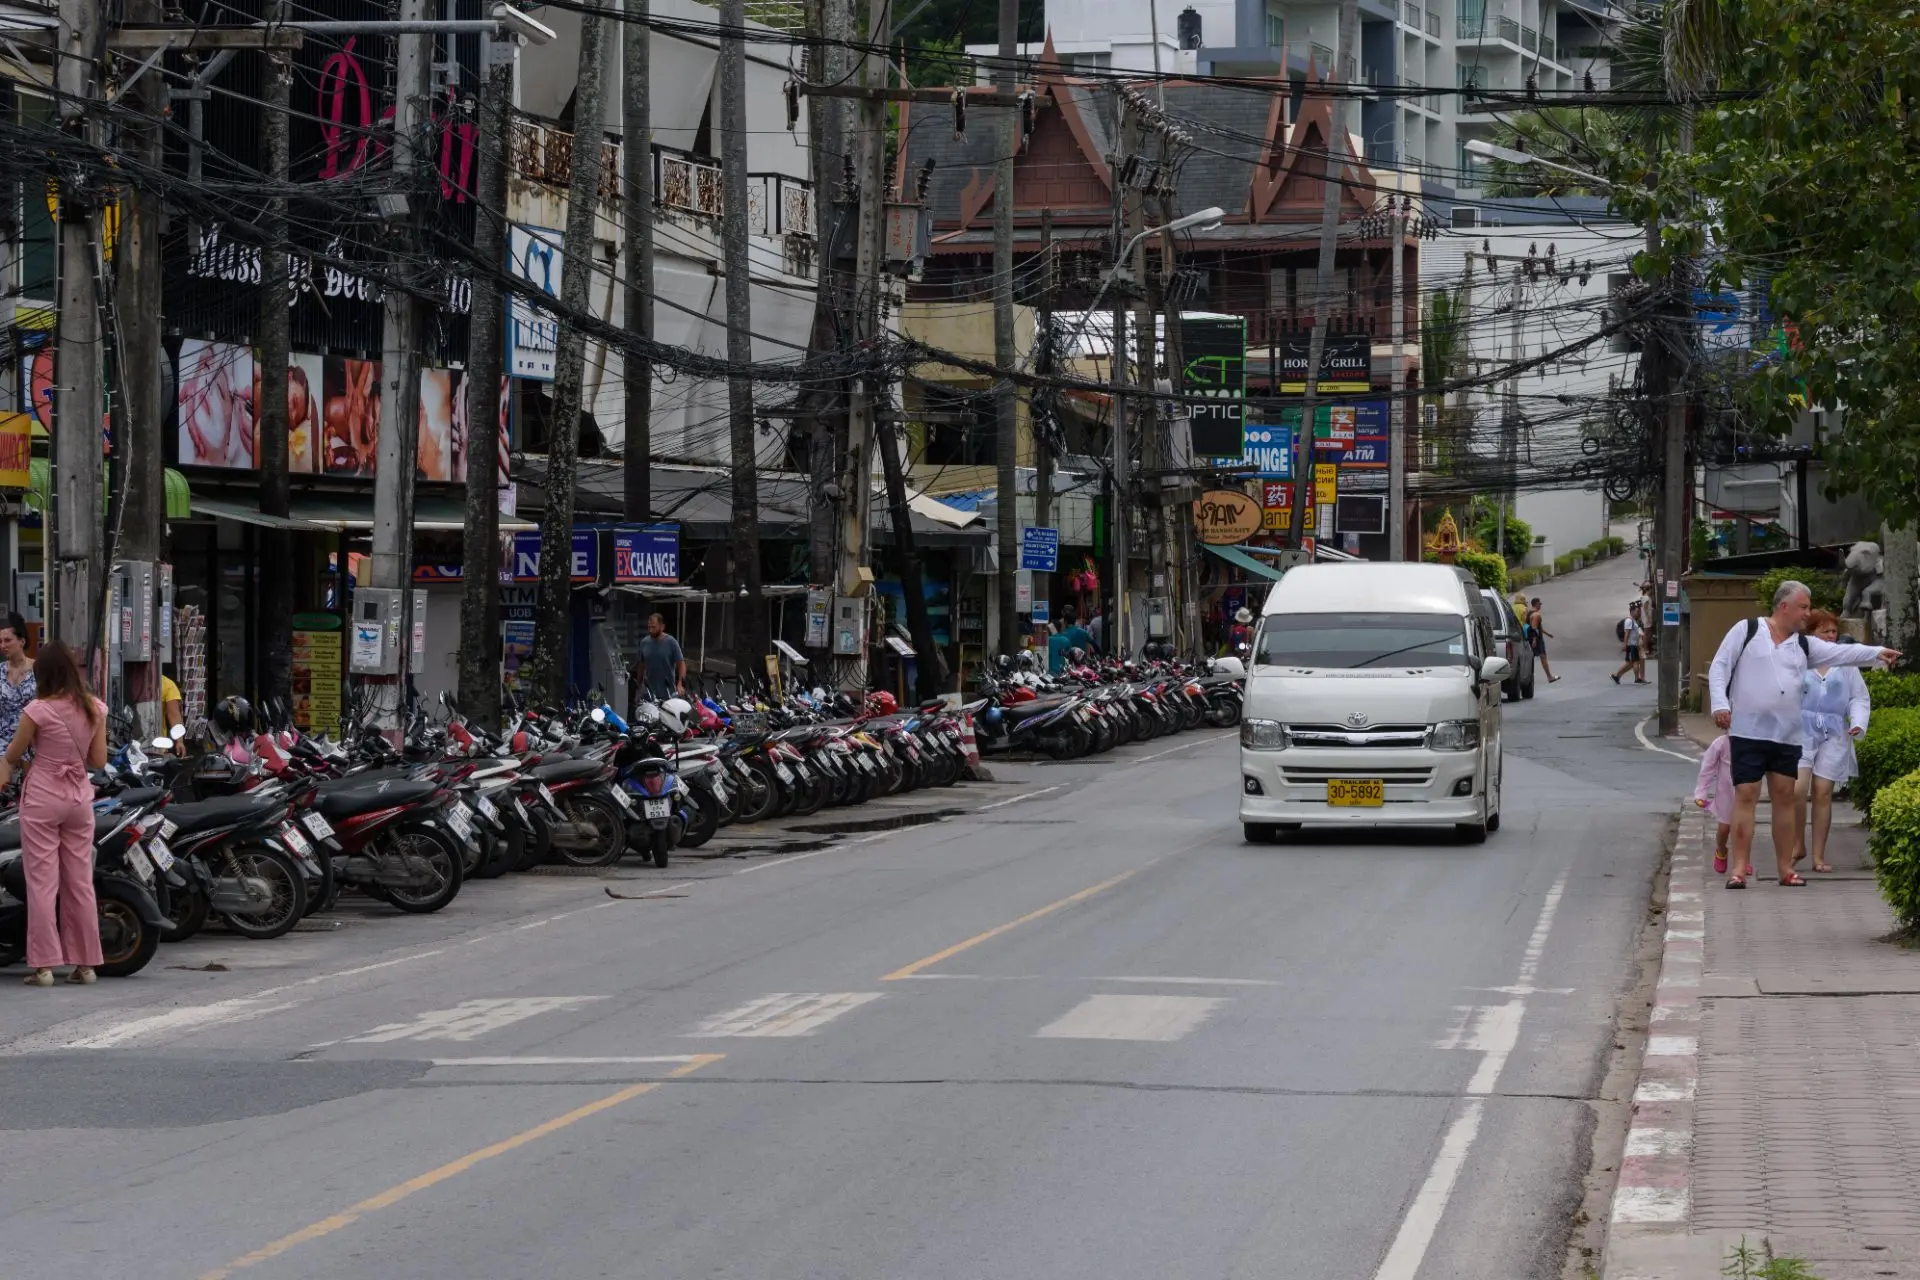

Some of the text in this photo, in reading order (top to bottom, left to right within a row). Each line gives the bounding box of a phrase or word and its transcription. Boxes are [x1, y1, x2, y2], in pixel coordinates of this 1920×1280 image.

[1331, 357, 1367, 369] GRILL
[1342, 449, 1376, 461] ATM
[1266, 511, 1312, 526] апта
[616, 551, 676, 577] EXCHANGE
[1330, 785, 1381, 799] 30-5892
